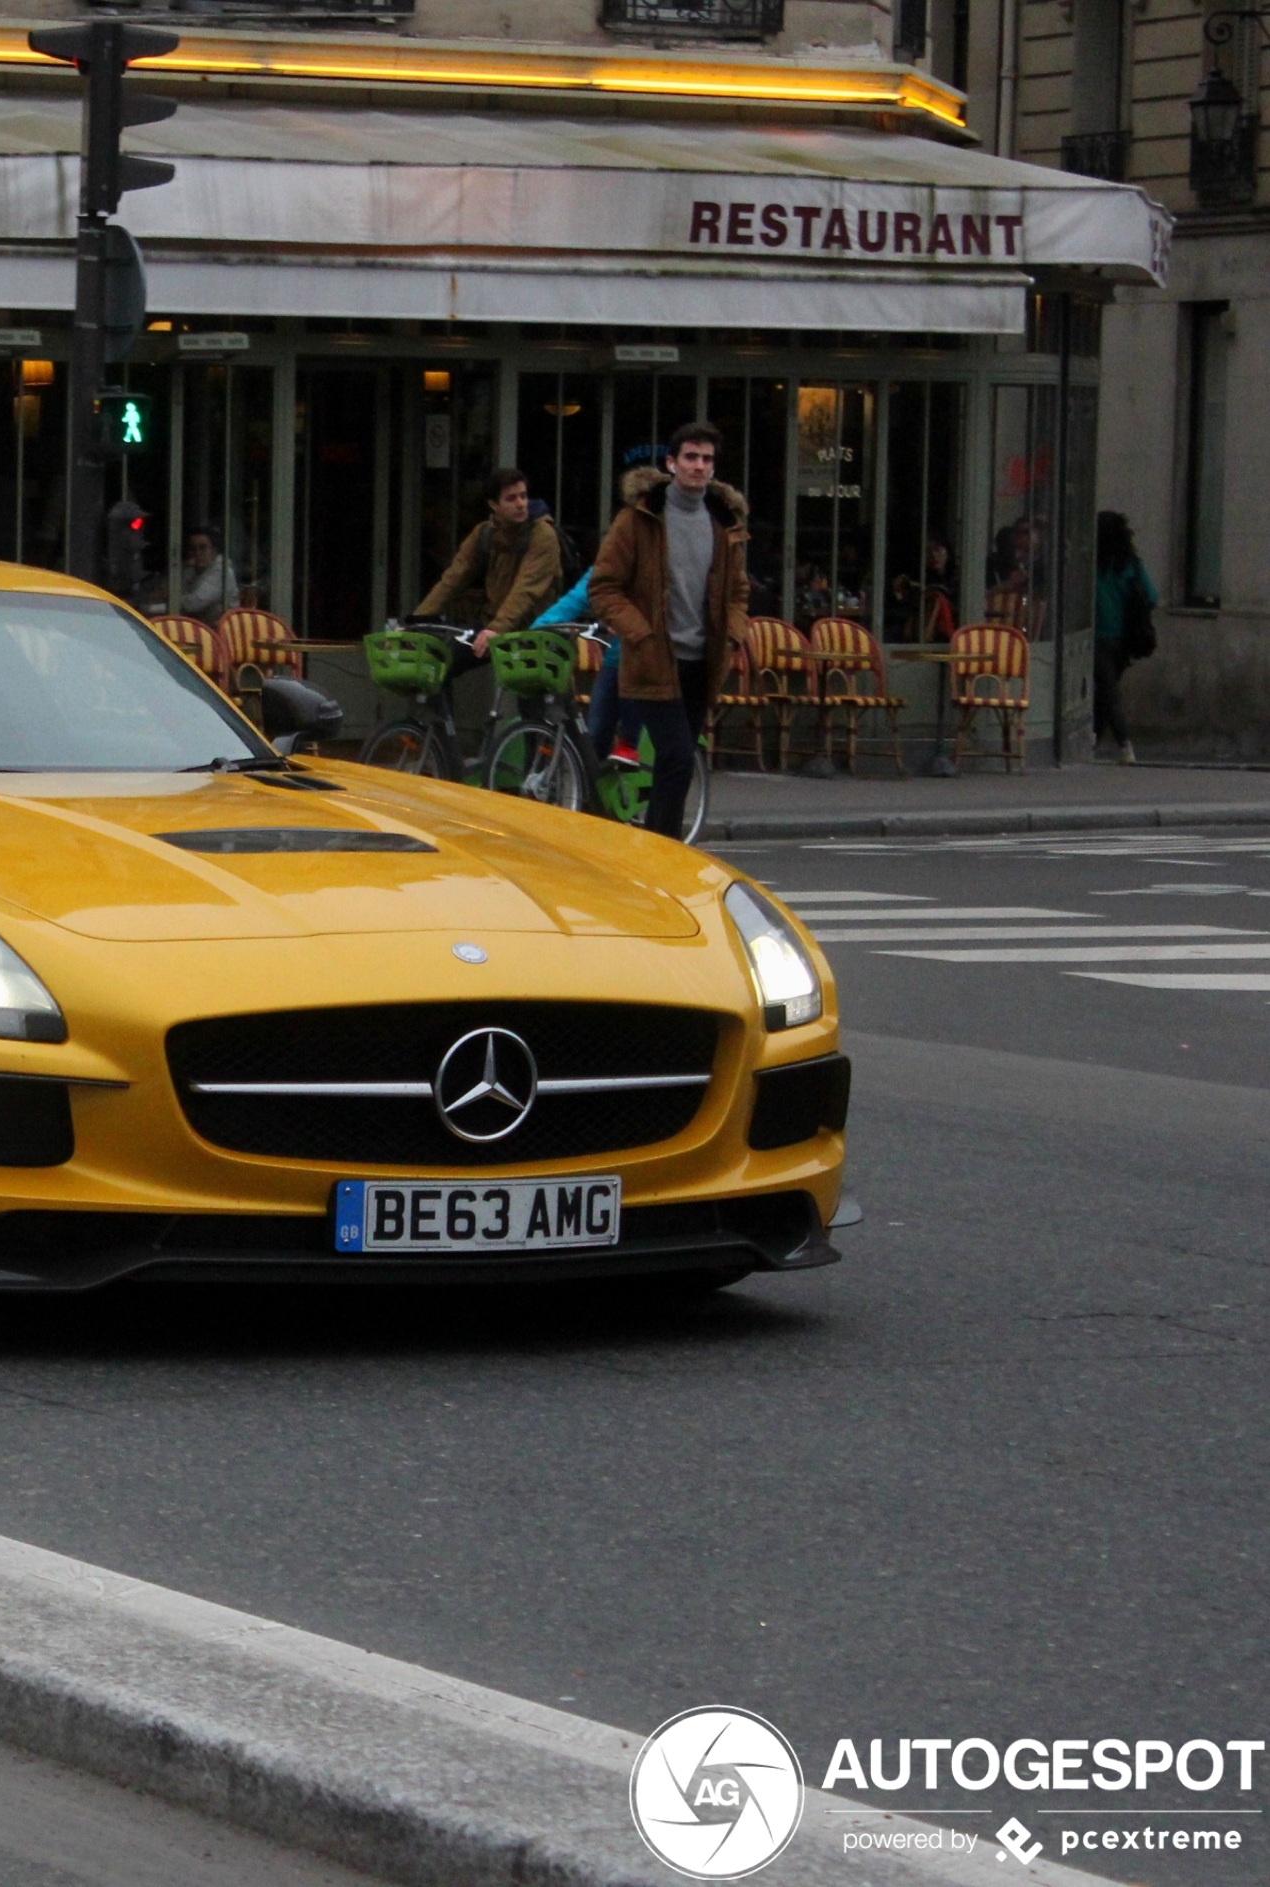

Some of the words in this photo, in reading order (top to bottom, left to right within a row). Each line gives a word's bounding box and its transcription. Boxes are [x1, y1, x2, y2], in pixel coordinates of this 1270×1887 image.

[689, 200, 1023, 256] RESTAURANT
[340, 1224, 359, 1238] GB
[373, 1188, 511, 1241] BE63
[525, 1184, 612, 1239] AMG
